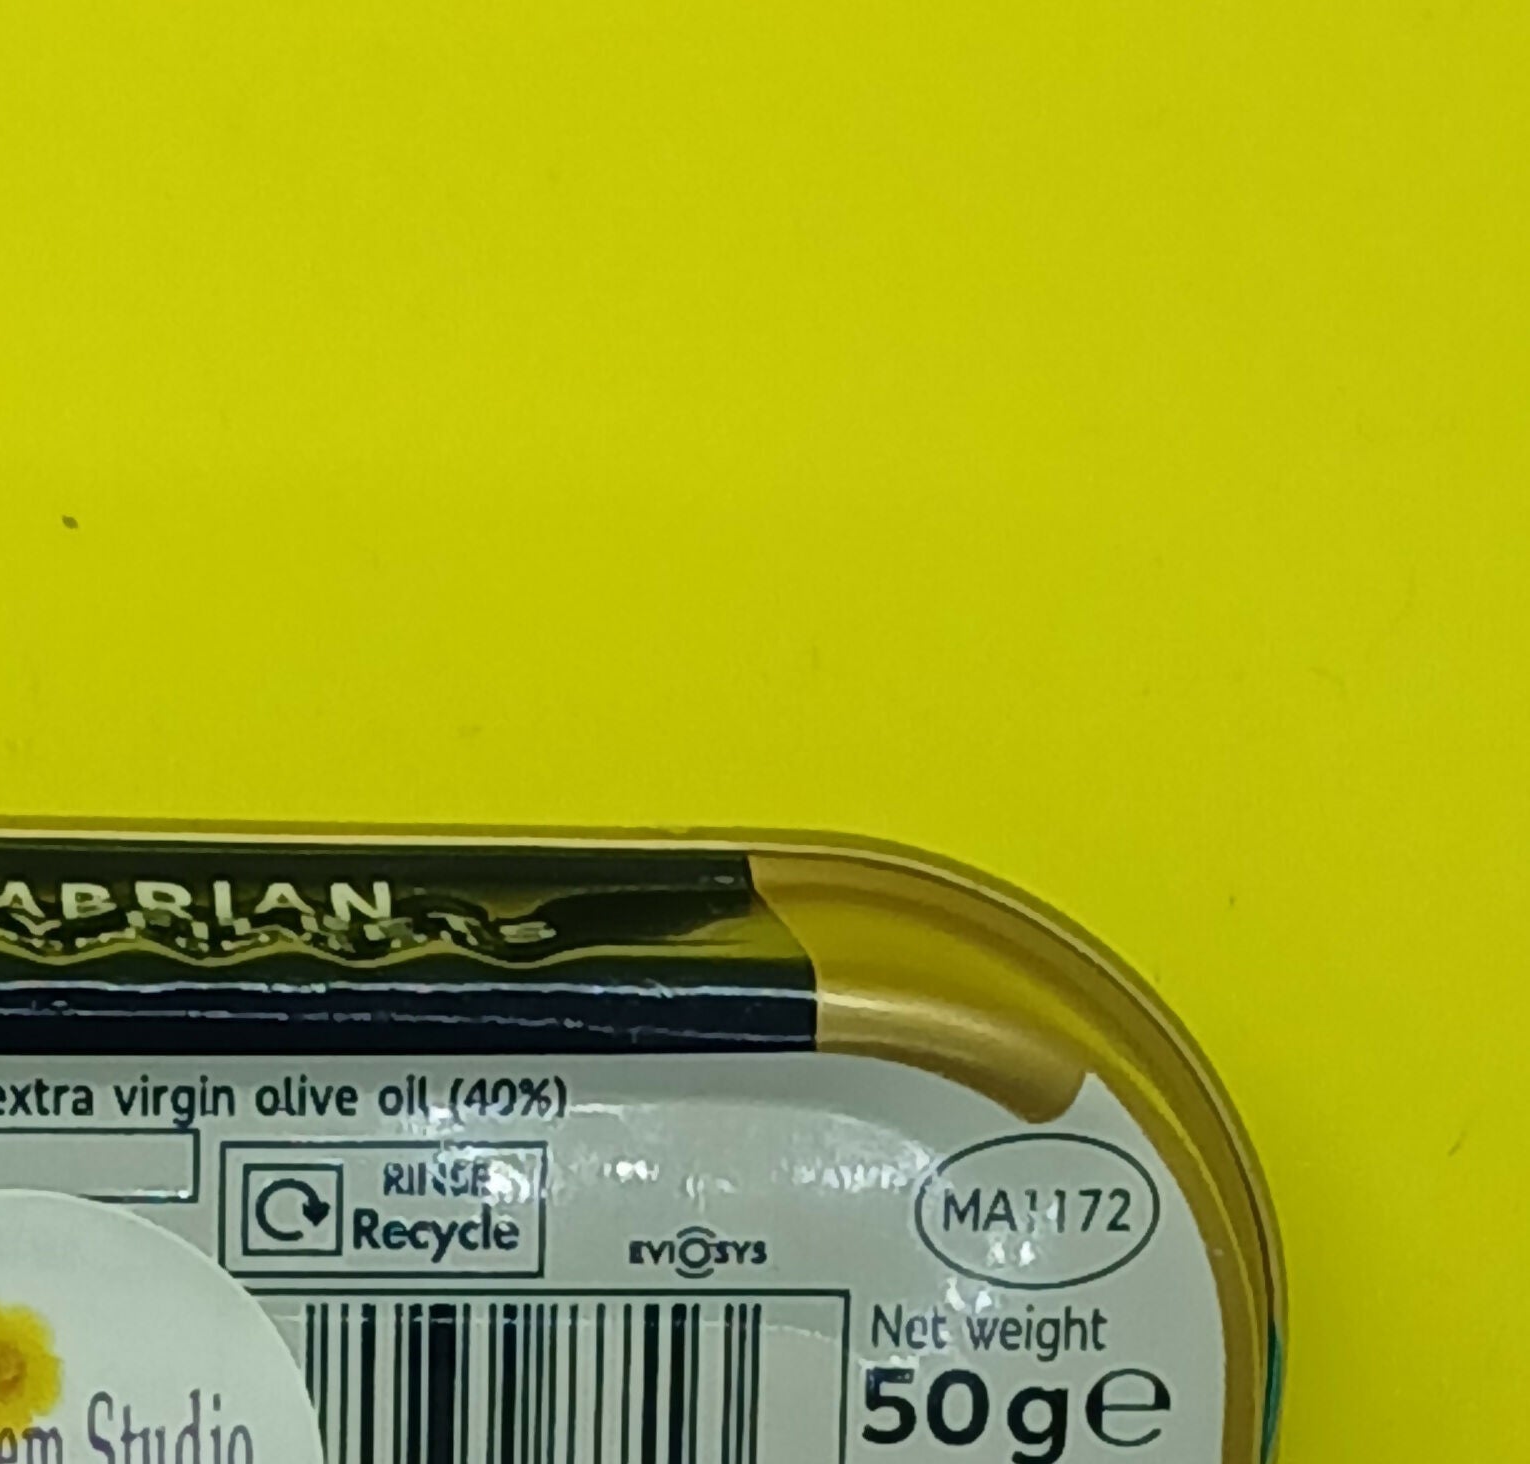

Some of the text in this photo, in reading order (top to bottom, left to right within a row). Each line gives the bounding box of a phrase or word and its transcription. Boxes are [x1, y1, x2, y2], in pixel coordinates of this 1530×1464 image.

[113, 1075, 235, 1128] virgin
[255, 1076, 357, 1116] olive
[378, 1077, 428, 1117] oil
[448, 1077, 567, 1118] (40%)
[353, 1208, 520, 1262] Recycle
[871, 1303, 1107, 1361] Net weight
